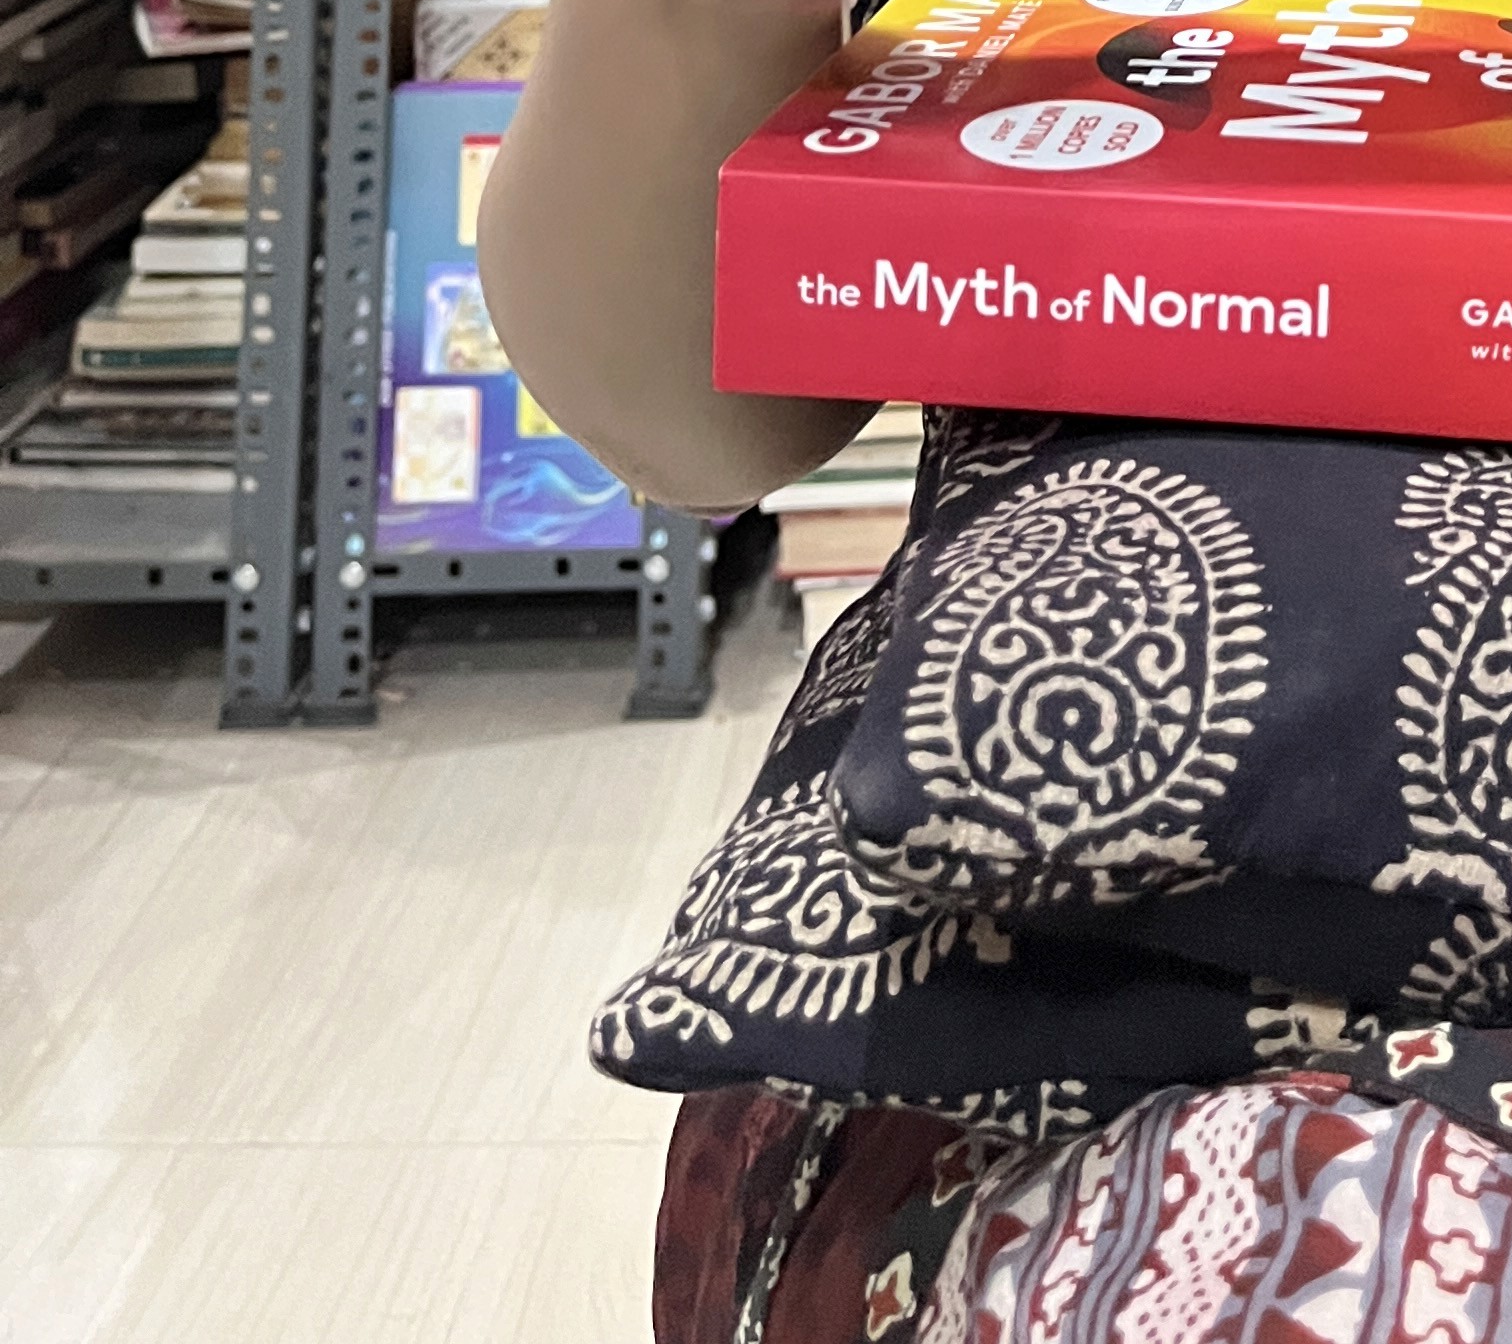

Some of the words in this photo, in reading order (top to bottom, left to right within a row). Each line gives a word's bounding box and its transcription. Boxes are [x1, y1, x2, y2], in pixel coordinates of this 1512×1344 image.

[997, 0, 1044, 32] MATÉ
[1125, 27, 1235, 88] the
[802, 37, 959, 155] GABOR
[1017, 105, 1067, 150] MILLION
[1057, 113, 1103, 155] COPIES
[1103, 120, 1140, 152] SOLD
[797, 272, 861, 308] the
[873, 257, 1038, 327] Myth
[1049, 288, 1092, 323] of
[1102, 272, 1331, 340] Normal
